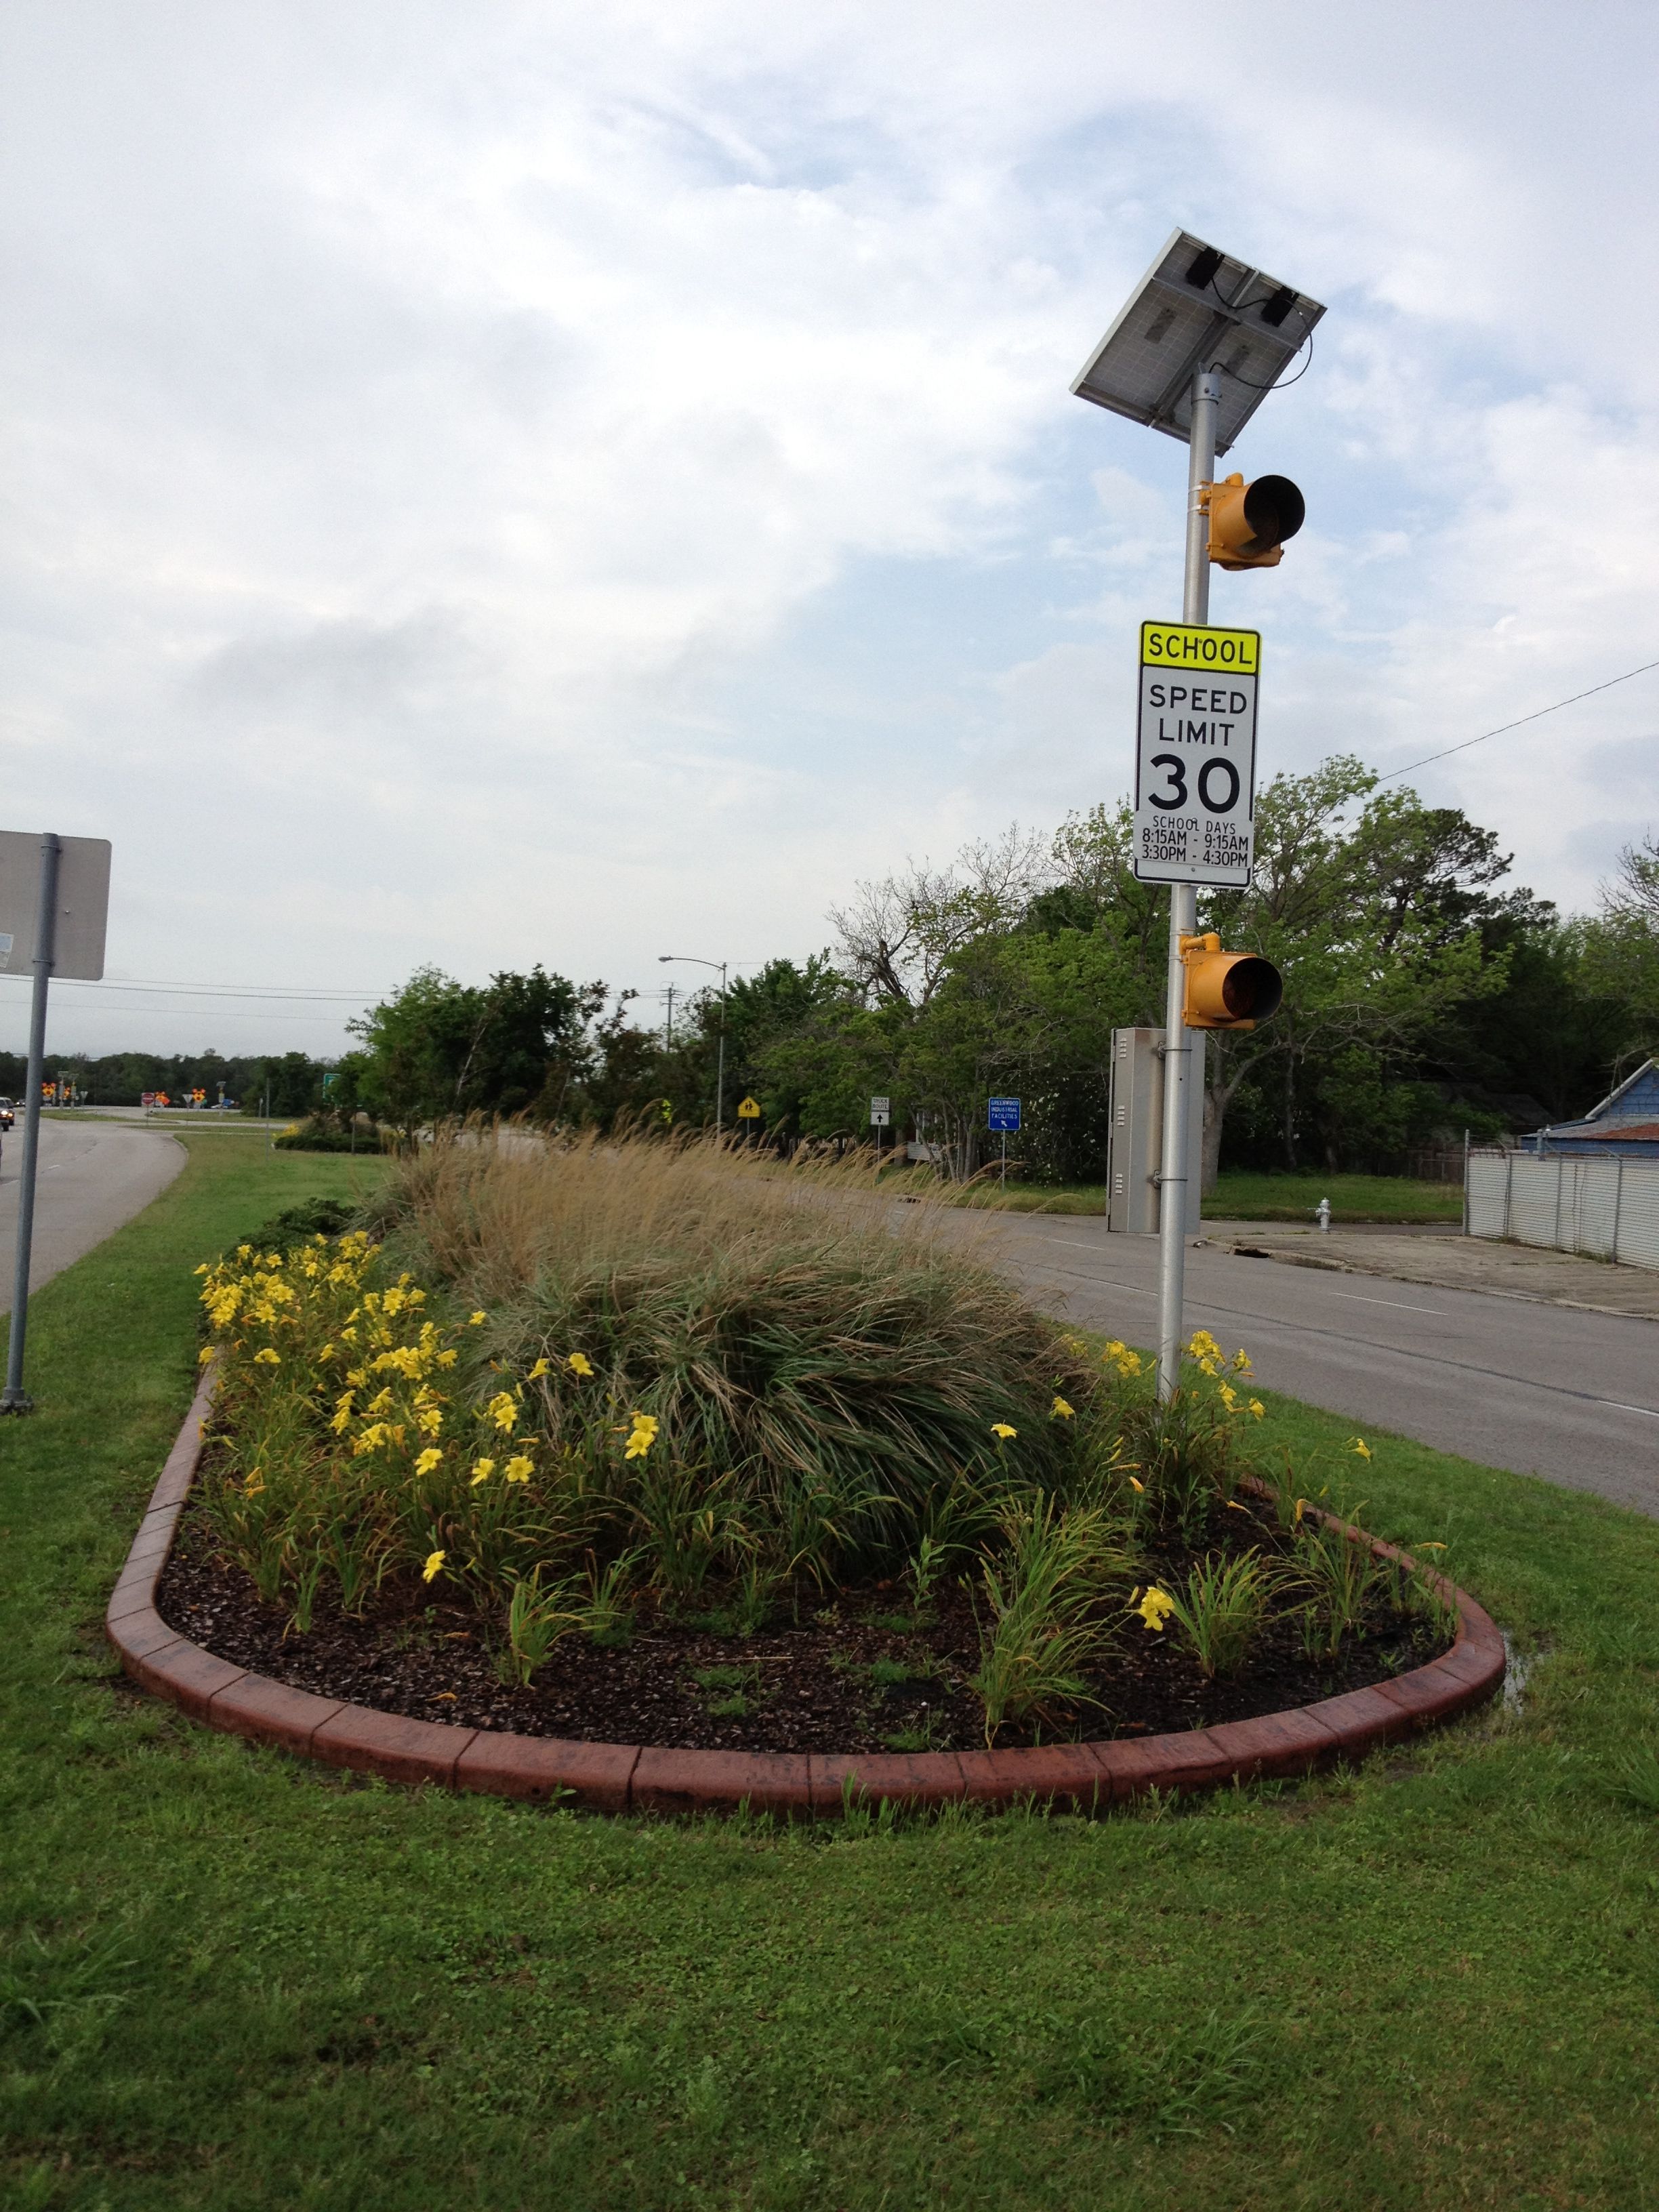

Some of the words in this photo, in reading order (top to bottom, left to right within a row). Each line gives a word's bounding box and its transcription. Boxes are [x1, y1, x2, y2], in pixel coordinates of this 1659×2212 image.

[1149, 633, 1252, 664] SCHOOL
[1149, 684, 1247, 714] SPEED
[1160, 718, 1235, 746] LIMIT
[1148, 754, 1240, 813] 30
[1153, 815, 1200, 832] SCHOOL
[1206, 821, 1235, 834] DAYS
[1142, 827, 1187, 845] 8:15AM
[1204, 834, 1248, 851] 9:15AM
[1142, 844, 1186, 862] 3:30PM
[1203, 850, 1248, 867] 4:30PM
